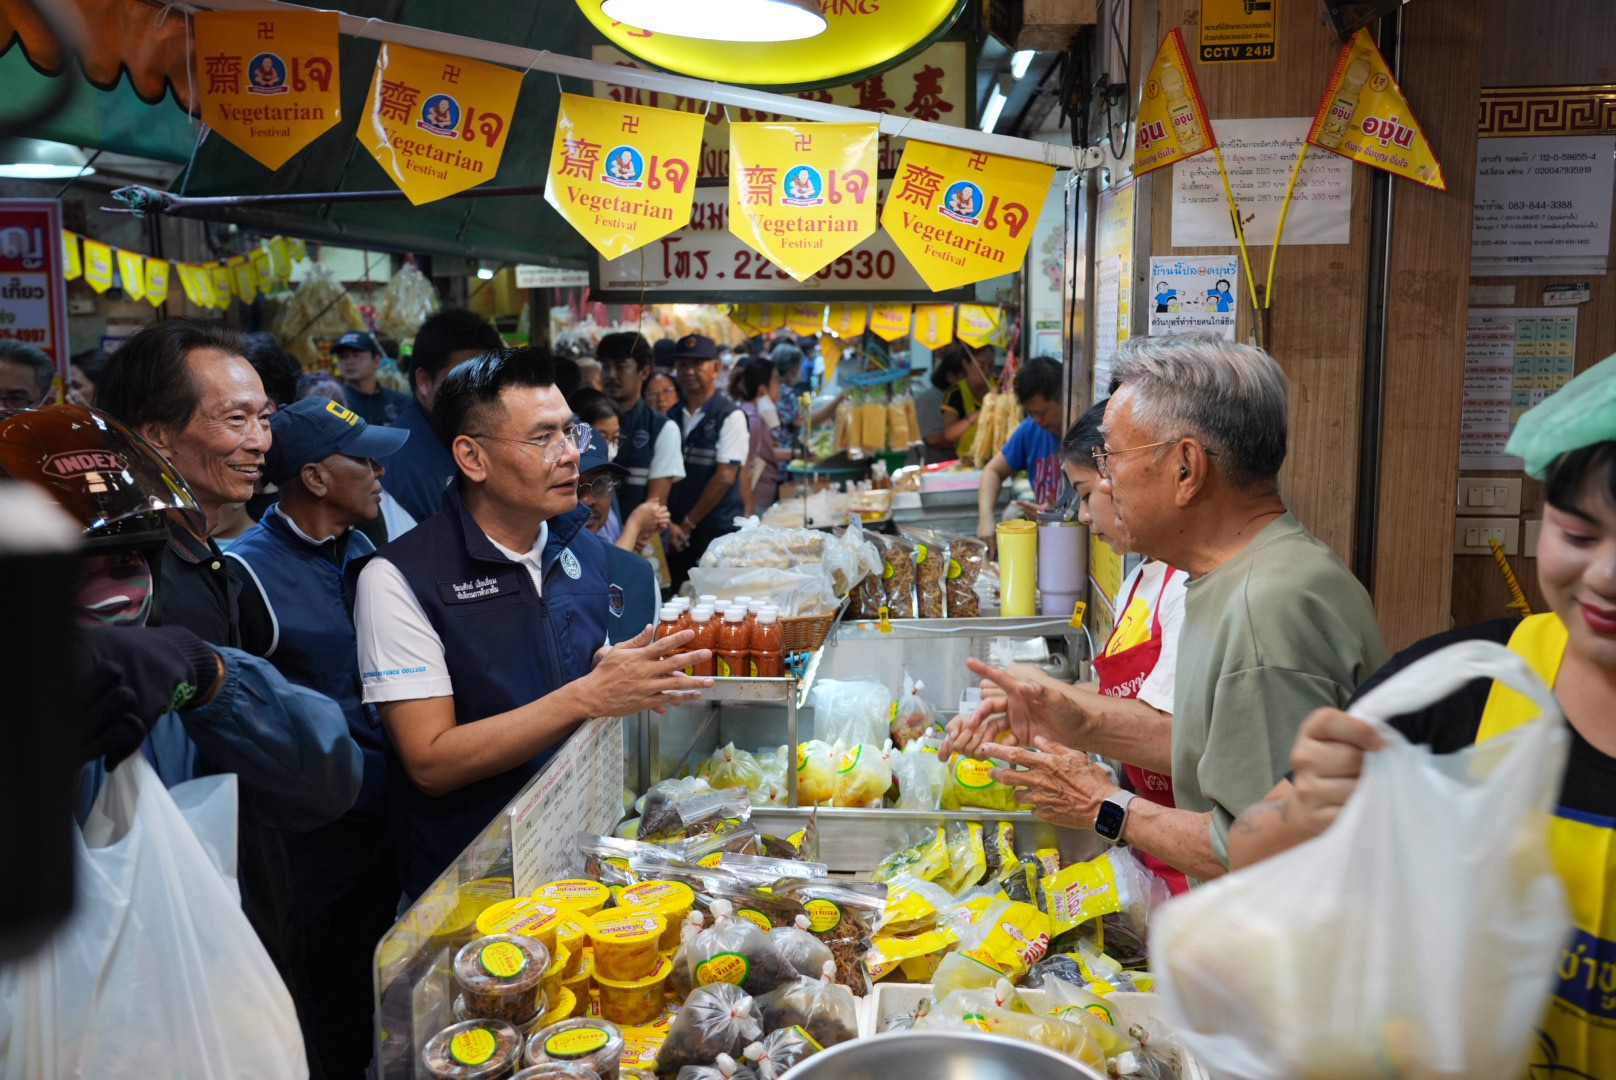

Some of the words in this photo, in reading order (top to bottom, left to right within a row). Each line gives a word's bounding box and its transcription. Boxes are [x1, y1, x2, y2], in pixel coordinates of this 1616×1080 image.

[816, 0, 880, 16] ANG
[1204, 46, 1240, 58] CCTV
[1245, 45, 1271, 56] 24H
[292, 57, 333, 93] เจ
[218, 103, 324, 125] Vegetarian
[1174, 112, 1194, 126] องุ่น
[1332, 106, 1351, 120] องุ่น
[250, 126, 291, 137] Festival
[462, 107, 504, 148] เจ
[1361, 116, 1416, 149] องุ่น
[383, 128, 484, 174] Vegetarian
[405, 159, 448, 180] Festival
[647, 155, 690, 194] เจ
[828, 169, 869, 205] เจ
[567, 186, 675, 221] Vegetarian
[594, 214, 638, 232] Festival
[749, 214, 859, 236] Vegetarian
[983, 196, 1030, 239] เจ
[781, 237, 824, 249] Festival
[902, 211, 1006, 264] Vegetarian
[661, 237, 725, 280] โทร.
[924, 244, 967, 267] Festival
[54, 453, 124, 475] INDEX
[401, 666, 427, 674] COLLEGE
